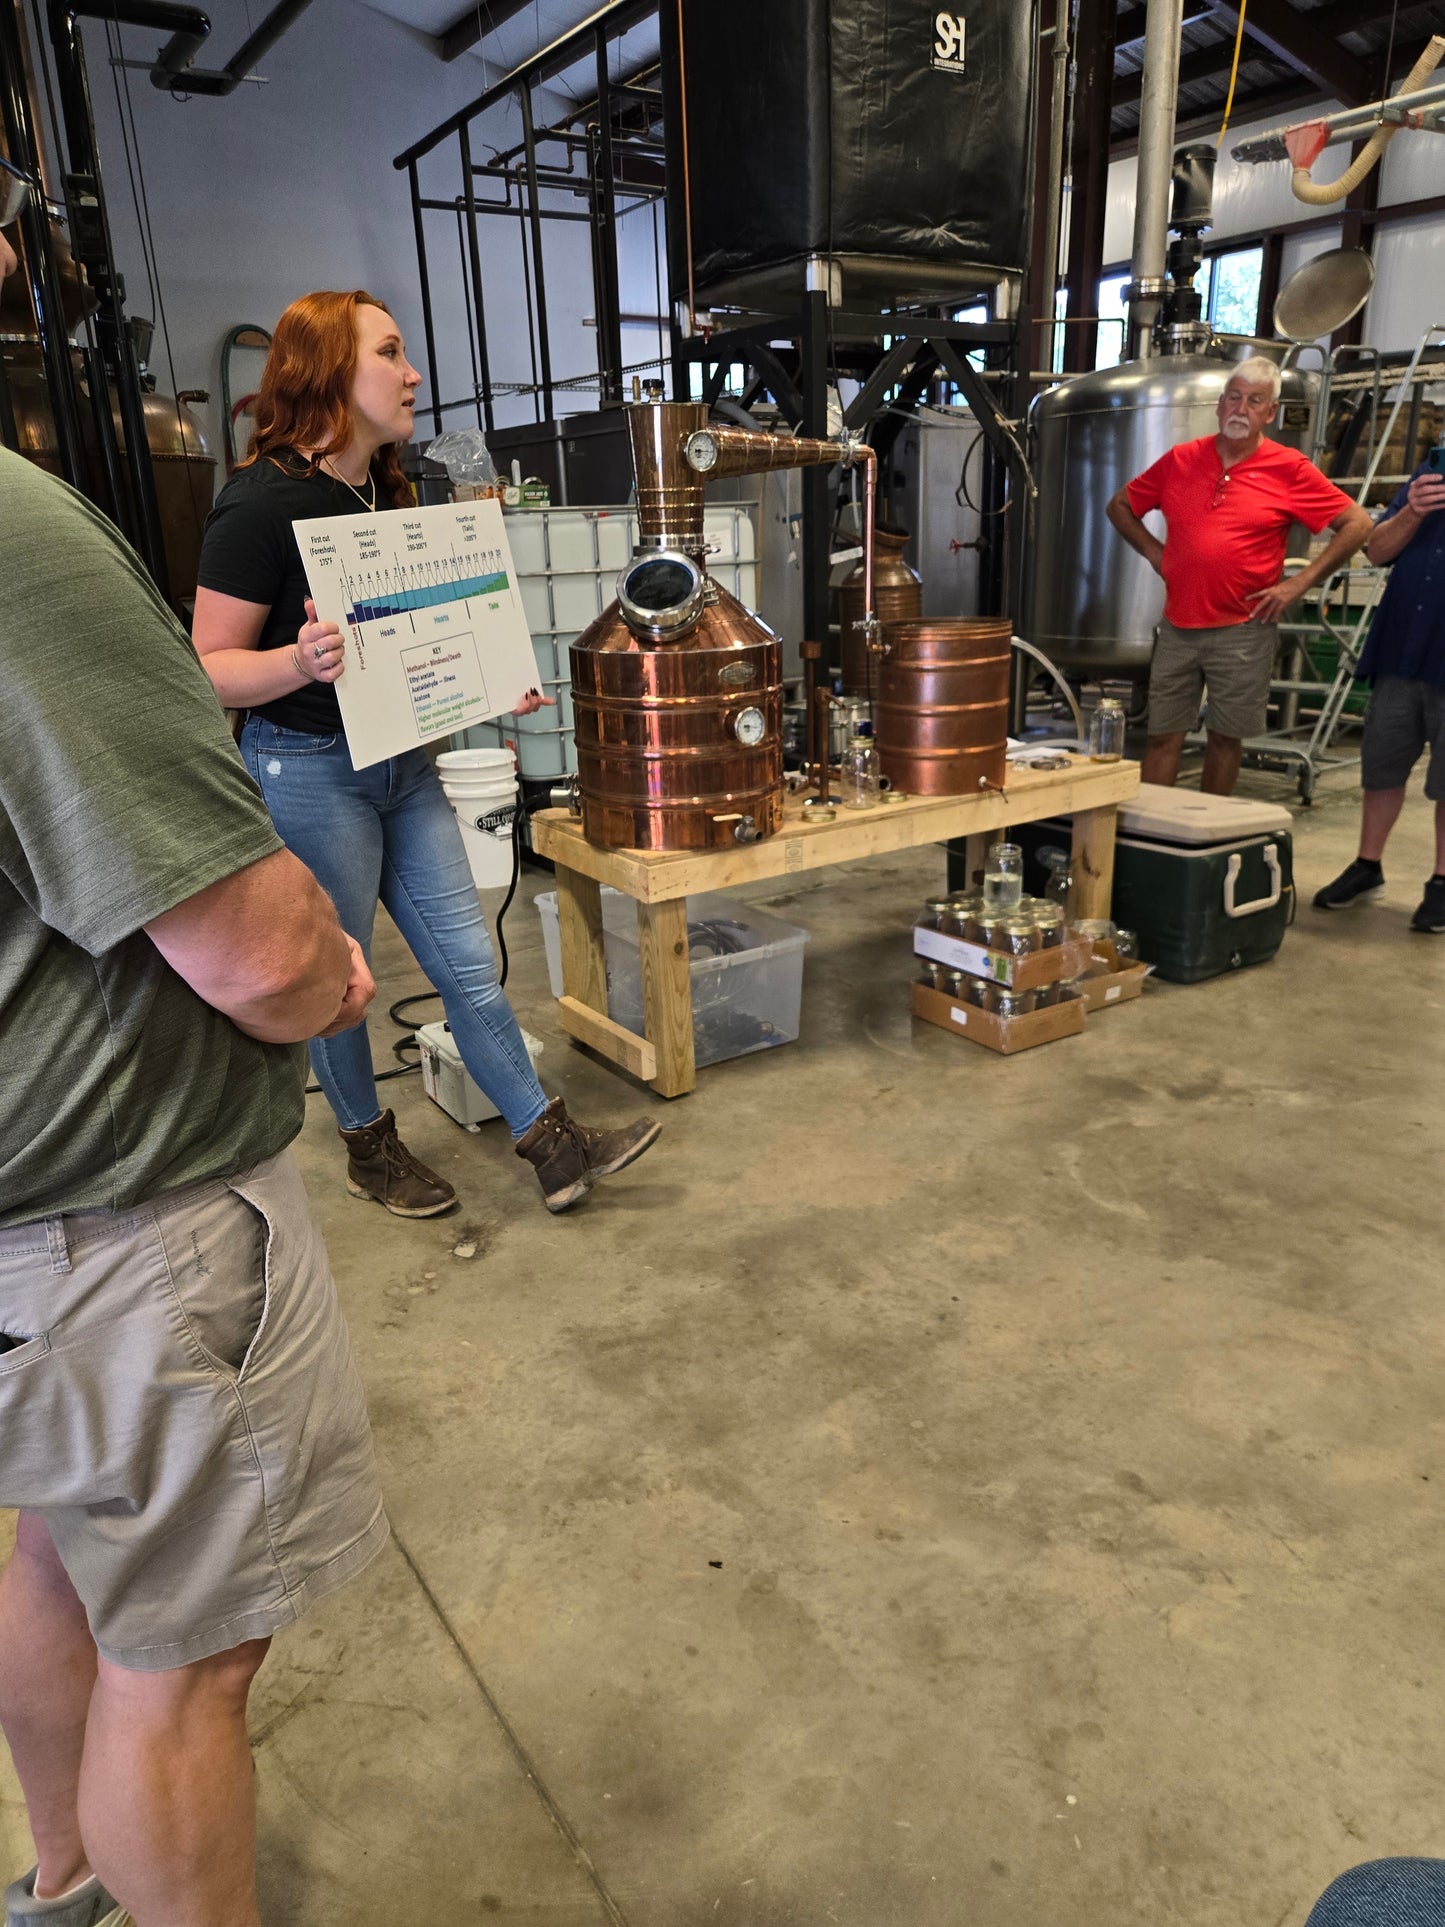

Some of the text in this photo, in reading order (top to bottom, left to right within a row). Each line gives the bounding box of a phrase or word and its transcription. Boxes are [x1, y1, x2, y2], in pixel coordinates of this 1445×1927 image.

[456, 515, 469, 523] Fourth
[352, 529, 369, 538] Second
[406, 532, 423, 541] (Hearts)
[310, 535, 322, 543] First
[359, 539, 376, 549] (Heads)
[310, 544, 336, 557] (Foreshots)
[488, 601, 500, 610] Tails
[434, 614, 450, 624] Hearts
[380, 627, 396, 637] Heads
[352, 626, 366, 670] Foreshots
[432, 647, 441, 655] KEY
[406, 662, 426, 673] Methanol
[409, 671, 435, 684] Ethyl acetate
[411, 680, 439, 693] Acetaldehyde
[414, 693, 431, 702] Acetone
[416, 702, 432, 713] Ethanol
[418, 714, 431, 723] Higher
[481, 815, 500, 829] STILL
